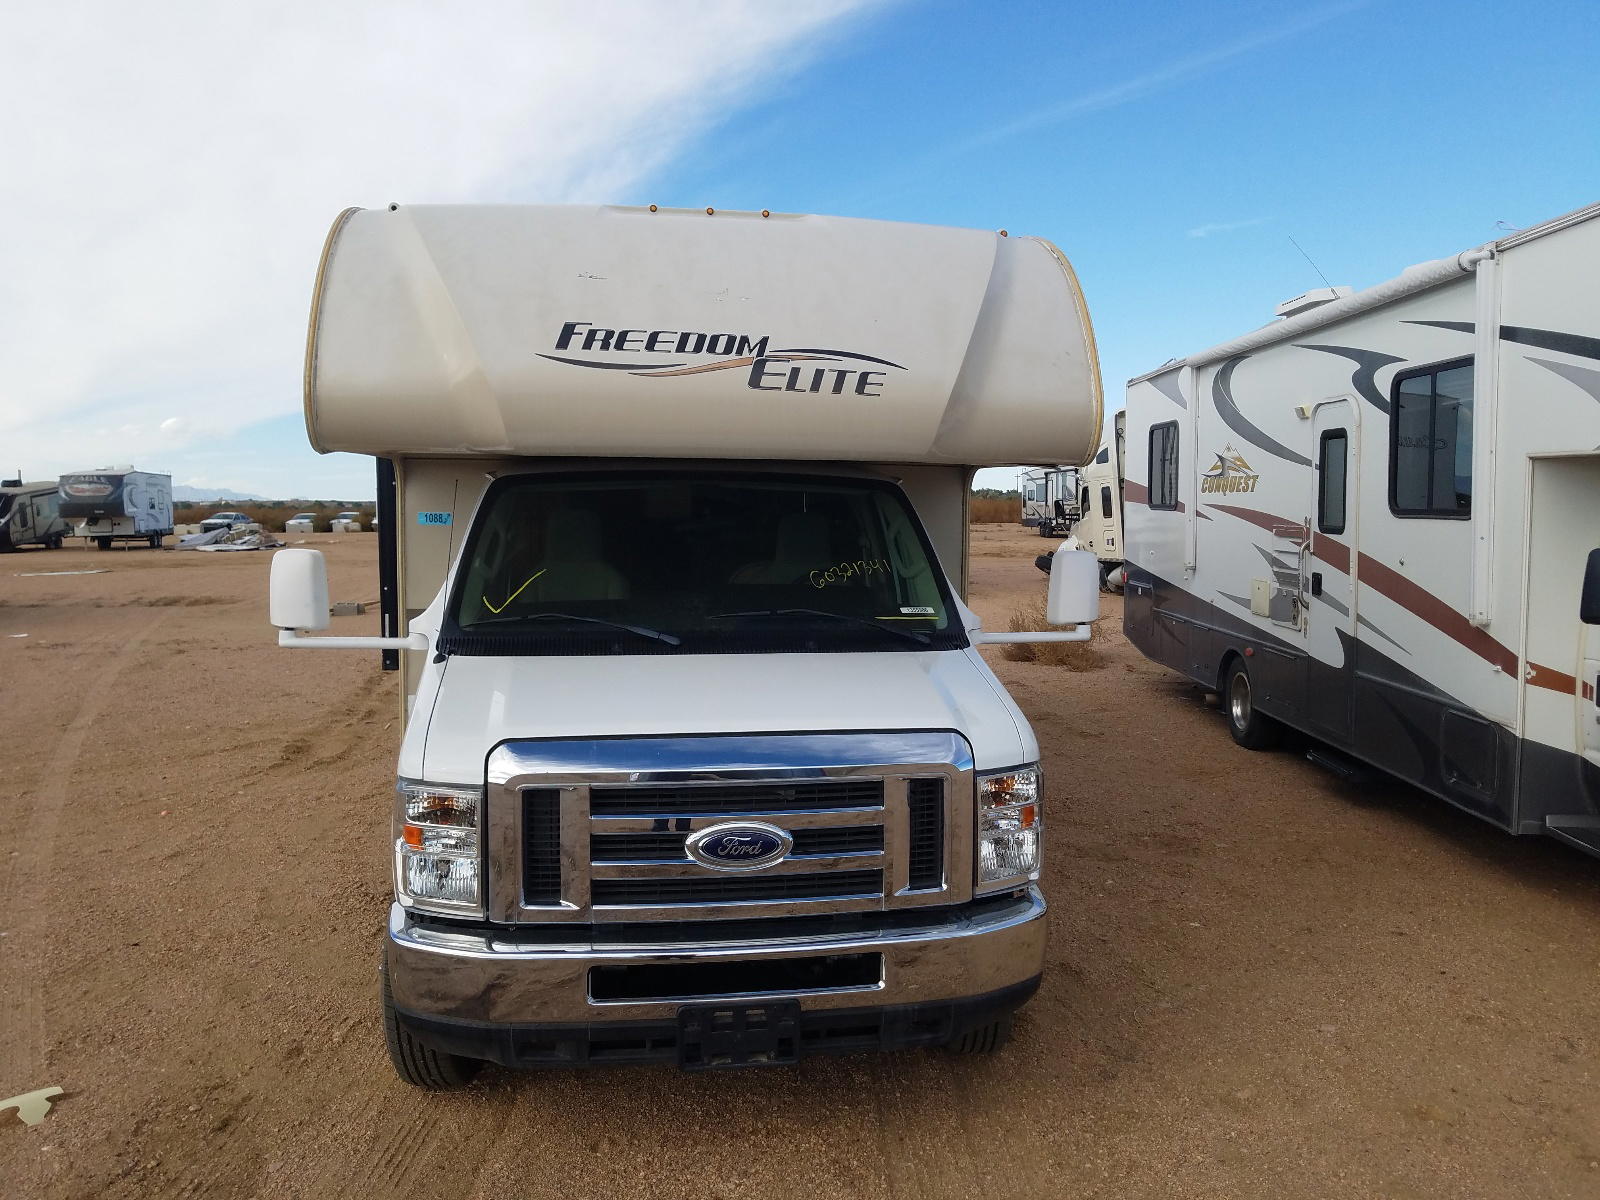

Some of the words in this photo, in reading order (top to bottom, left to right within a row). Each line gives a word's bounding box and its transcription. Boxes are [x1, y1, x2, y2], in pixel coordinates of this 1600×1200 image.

[555, 321, 770, 357] FREEDOM
[748, 358, 887, 397] ELITE
[1200, 474, 1260, 496] CONQUEST
[717, 836, 763, 856] Ford
